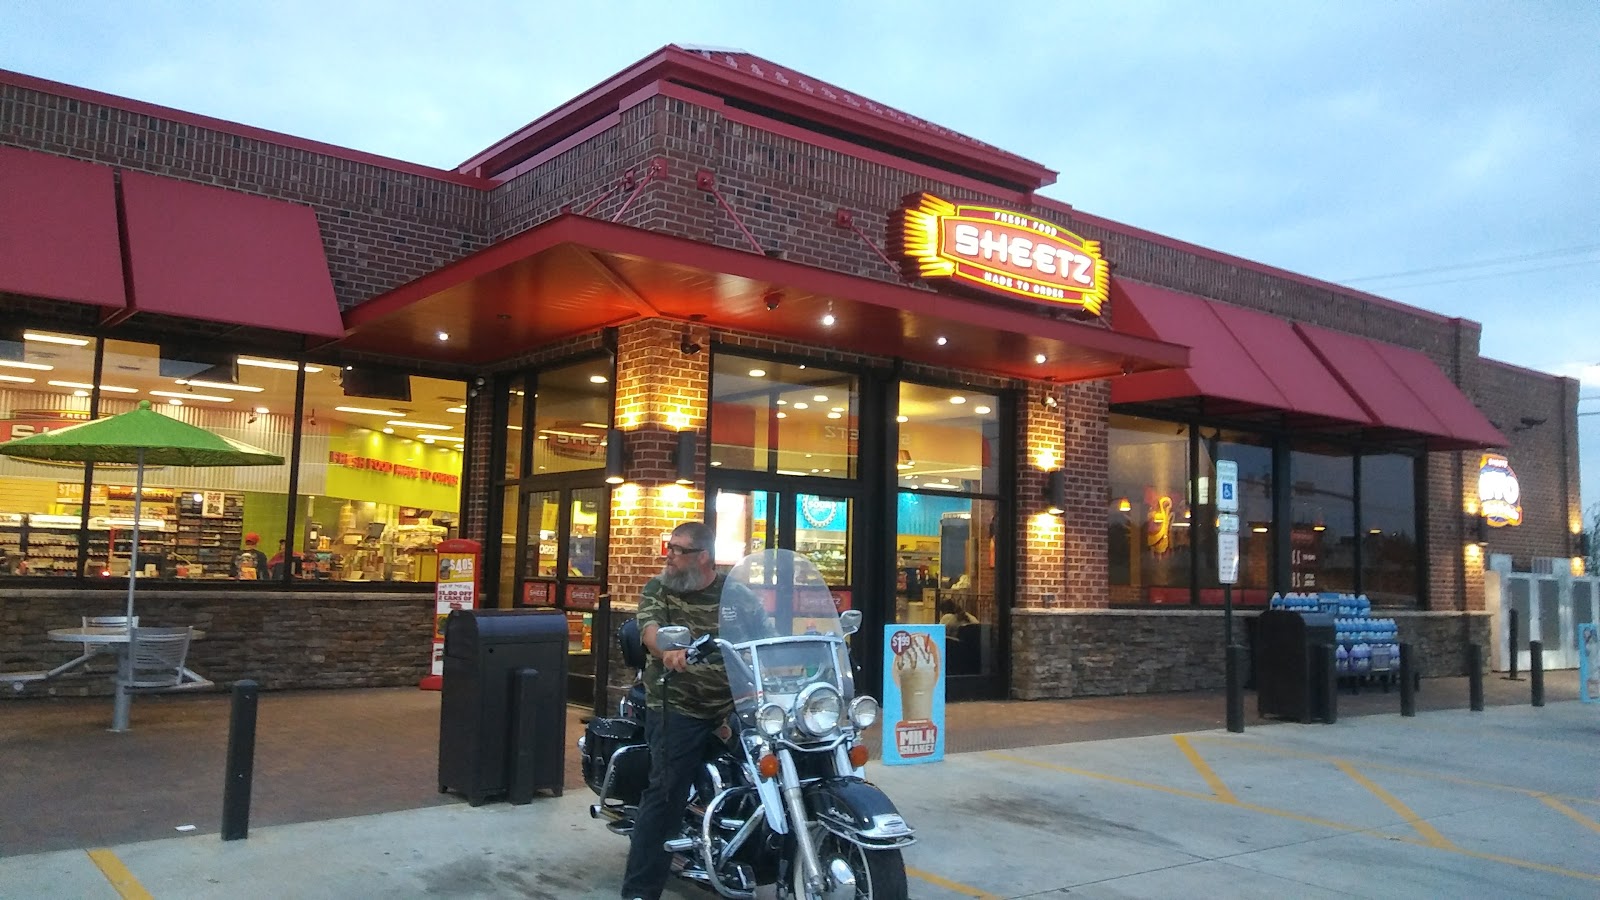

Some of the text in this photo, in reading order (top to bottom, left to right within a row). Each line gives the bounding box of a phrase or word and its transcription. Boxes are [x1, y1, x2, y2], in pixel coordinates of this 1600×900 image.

[994, 212, 1058, 237] FRESH FOOD
[954, 224, 1092, 284] SHEETZ
[984, 271, 1065, 299] MADE TO ORDER
[571, 592, 595, 600] SHEETZ
[900, 729, 935, 746] MILK
